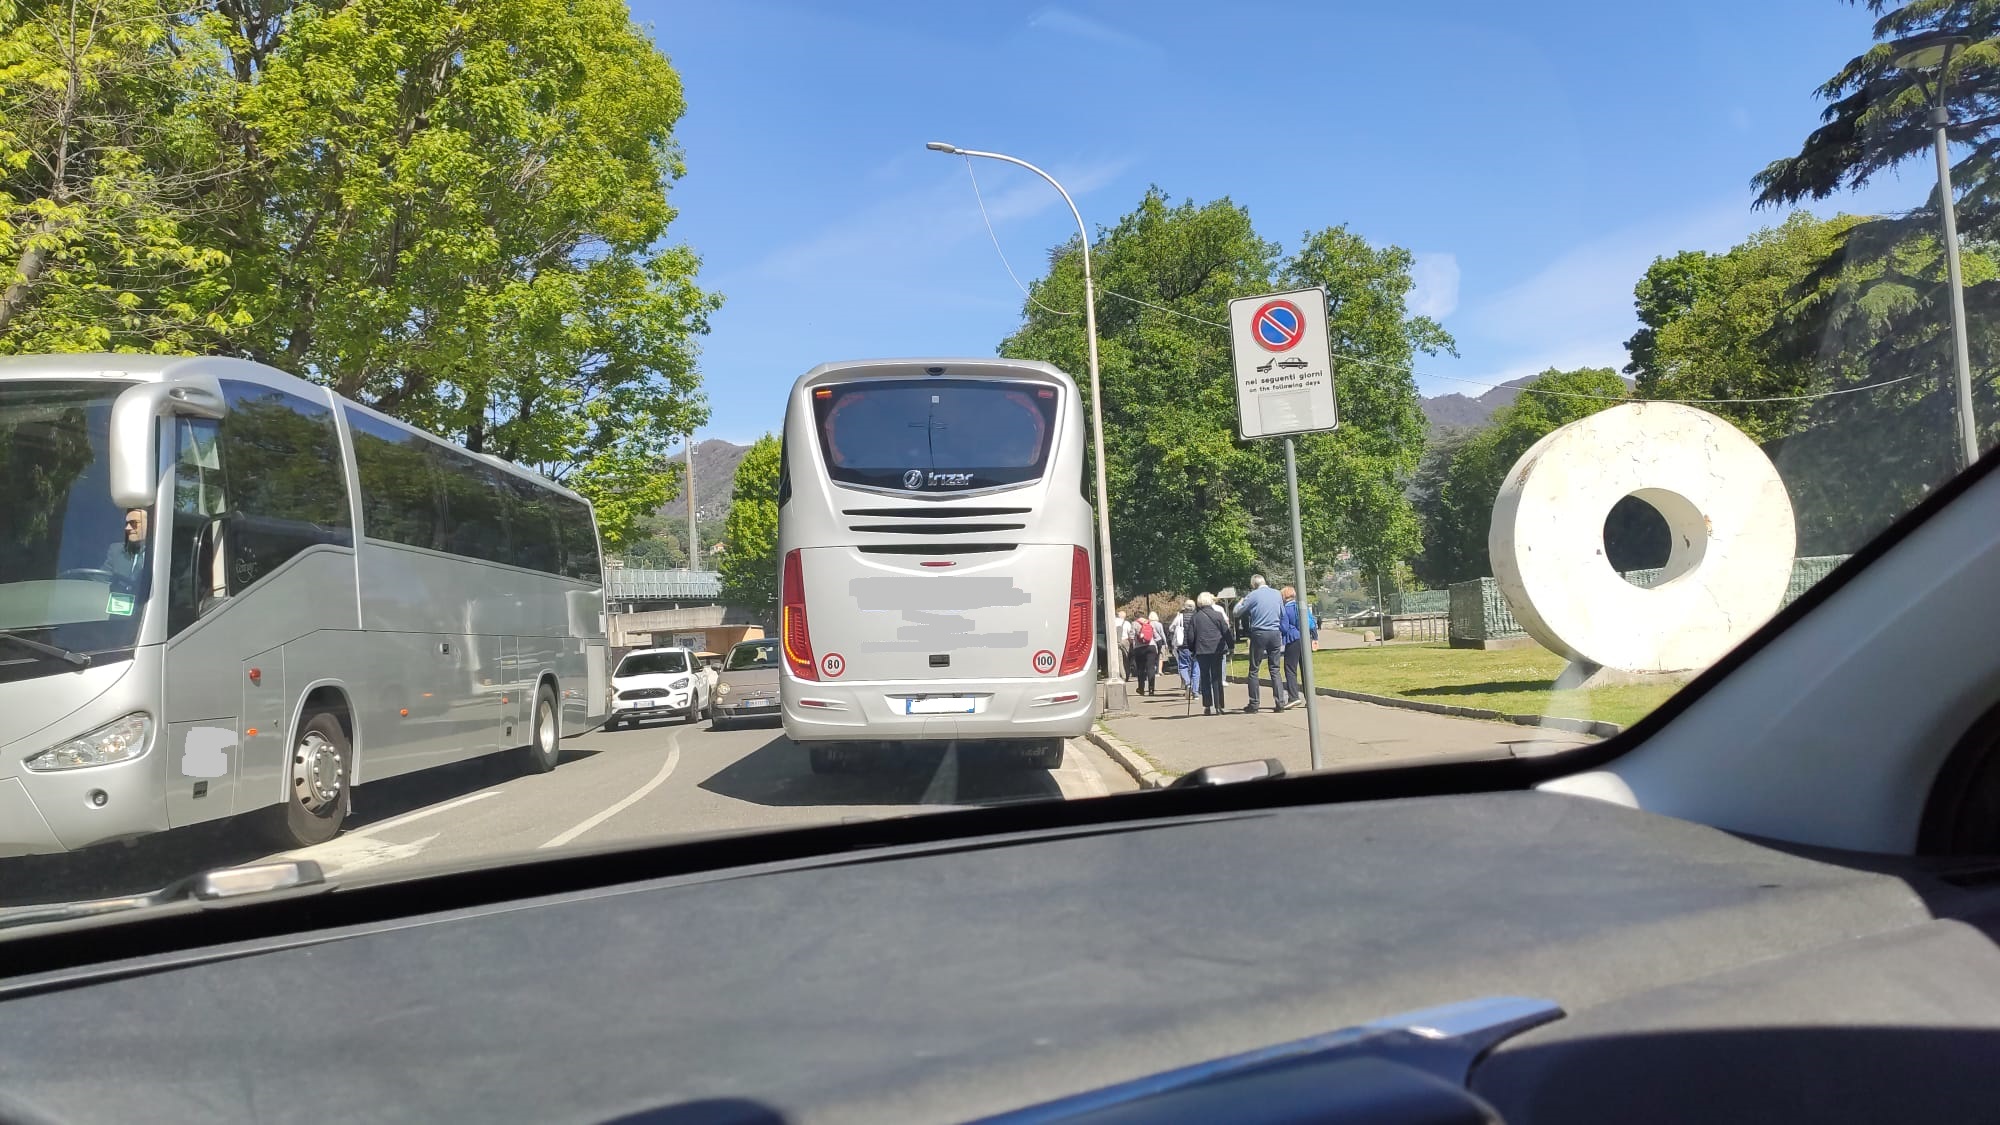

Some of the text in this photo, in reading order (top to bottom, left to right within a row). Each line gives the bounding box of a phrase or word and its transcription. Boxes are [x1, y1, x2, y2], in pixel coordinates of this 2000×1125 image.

[1245, 370, 1323, 386] nei seguenti giorni
[1272, 382, 1303, 390] following
[827, 659, 840, 670] 80
[1037, 655, 1053, 666] 100
